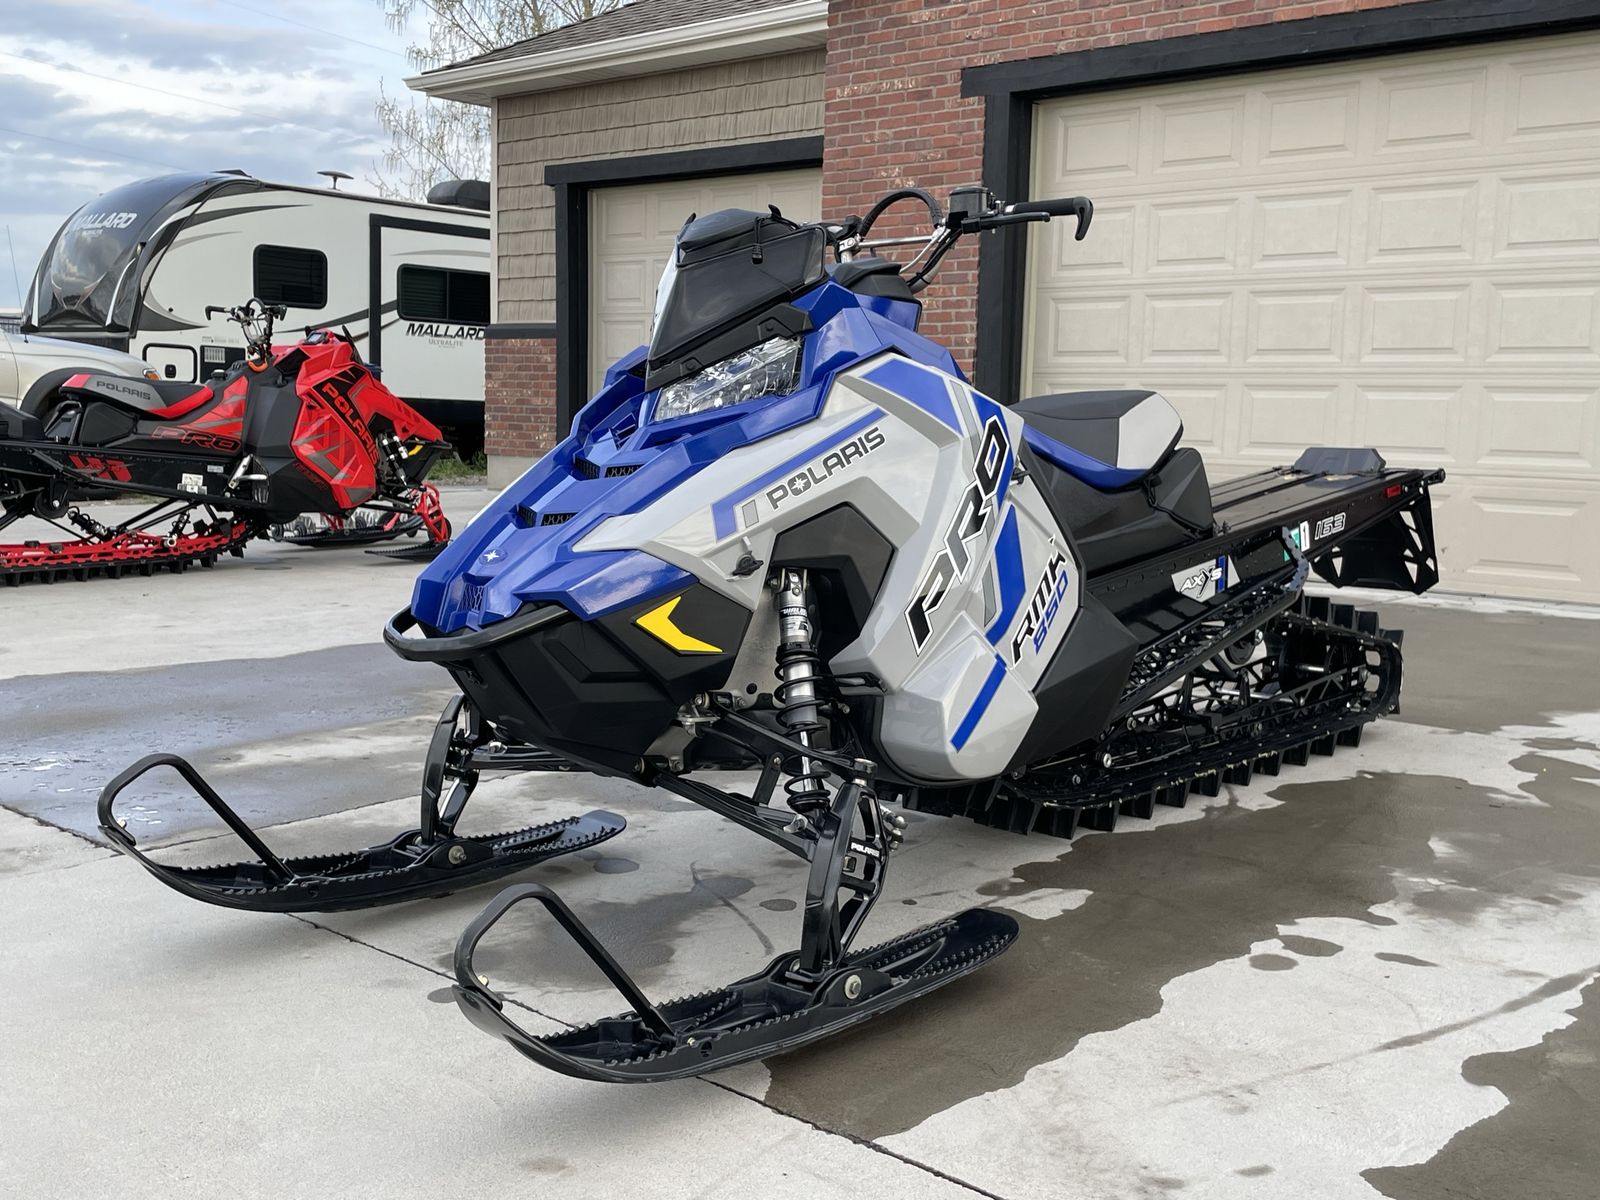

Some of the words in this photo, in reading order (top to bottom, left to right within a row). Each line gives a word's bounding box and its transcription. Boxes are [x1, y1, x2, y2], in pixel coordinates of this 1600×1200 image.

[406, 323, 485, 341] MALLARD
[97, 381, 151, 400] POLARIS
[152, 426, 241, 451] PRO
[322, 382, 379, 466] POLARIS
[767, 427, 885, 510] POLARIS
[905, 415, 1010, 657] PRO
[1314, 512, 1346, 540] 163
[1180, 565, 1222, 599] AXYS
[1011, 533, 1067, 667] RMK
[1033, 569, 1068, 656] 850
[851, 842, 880, 858] POLARIS
